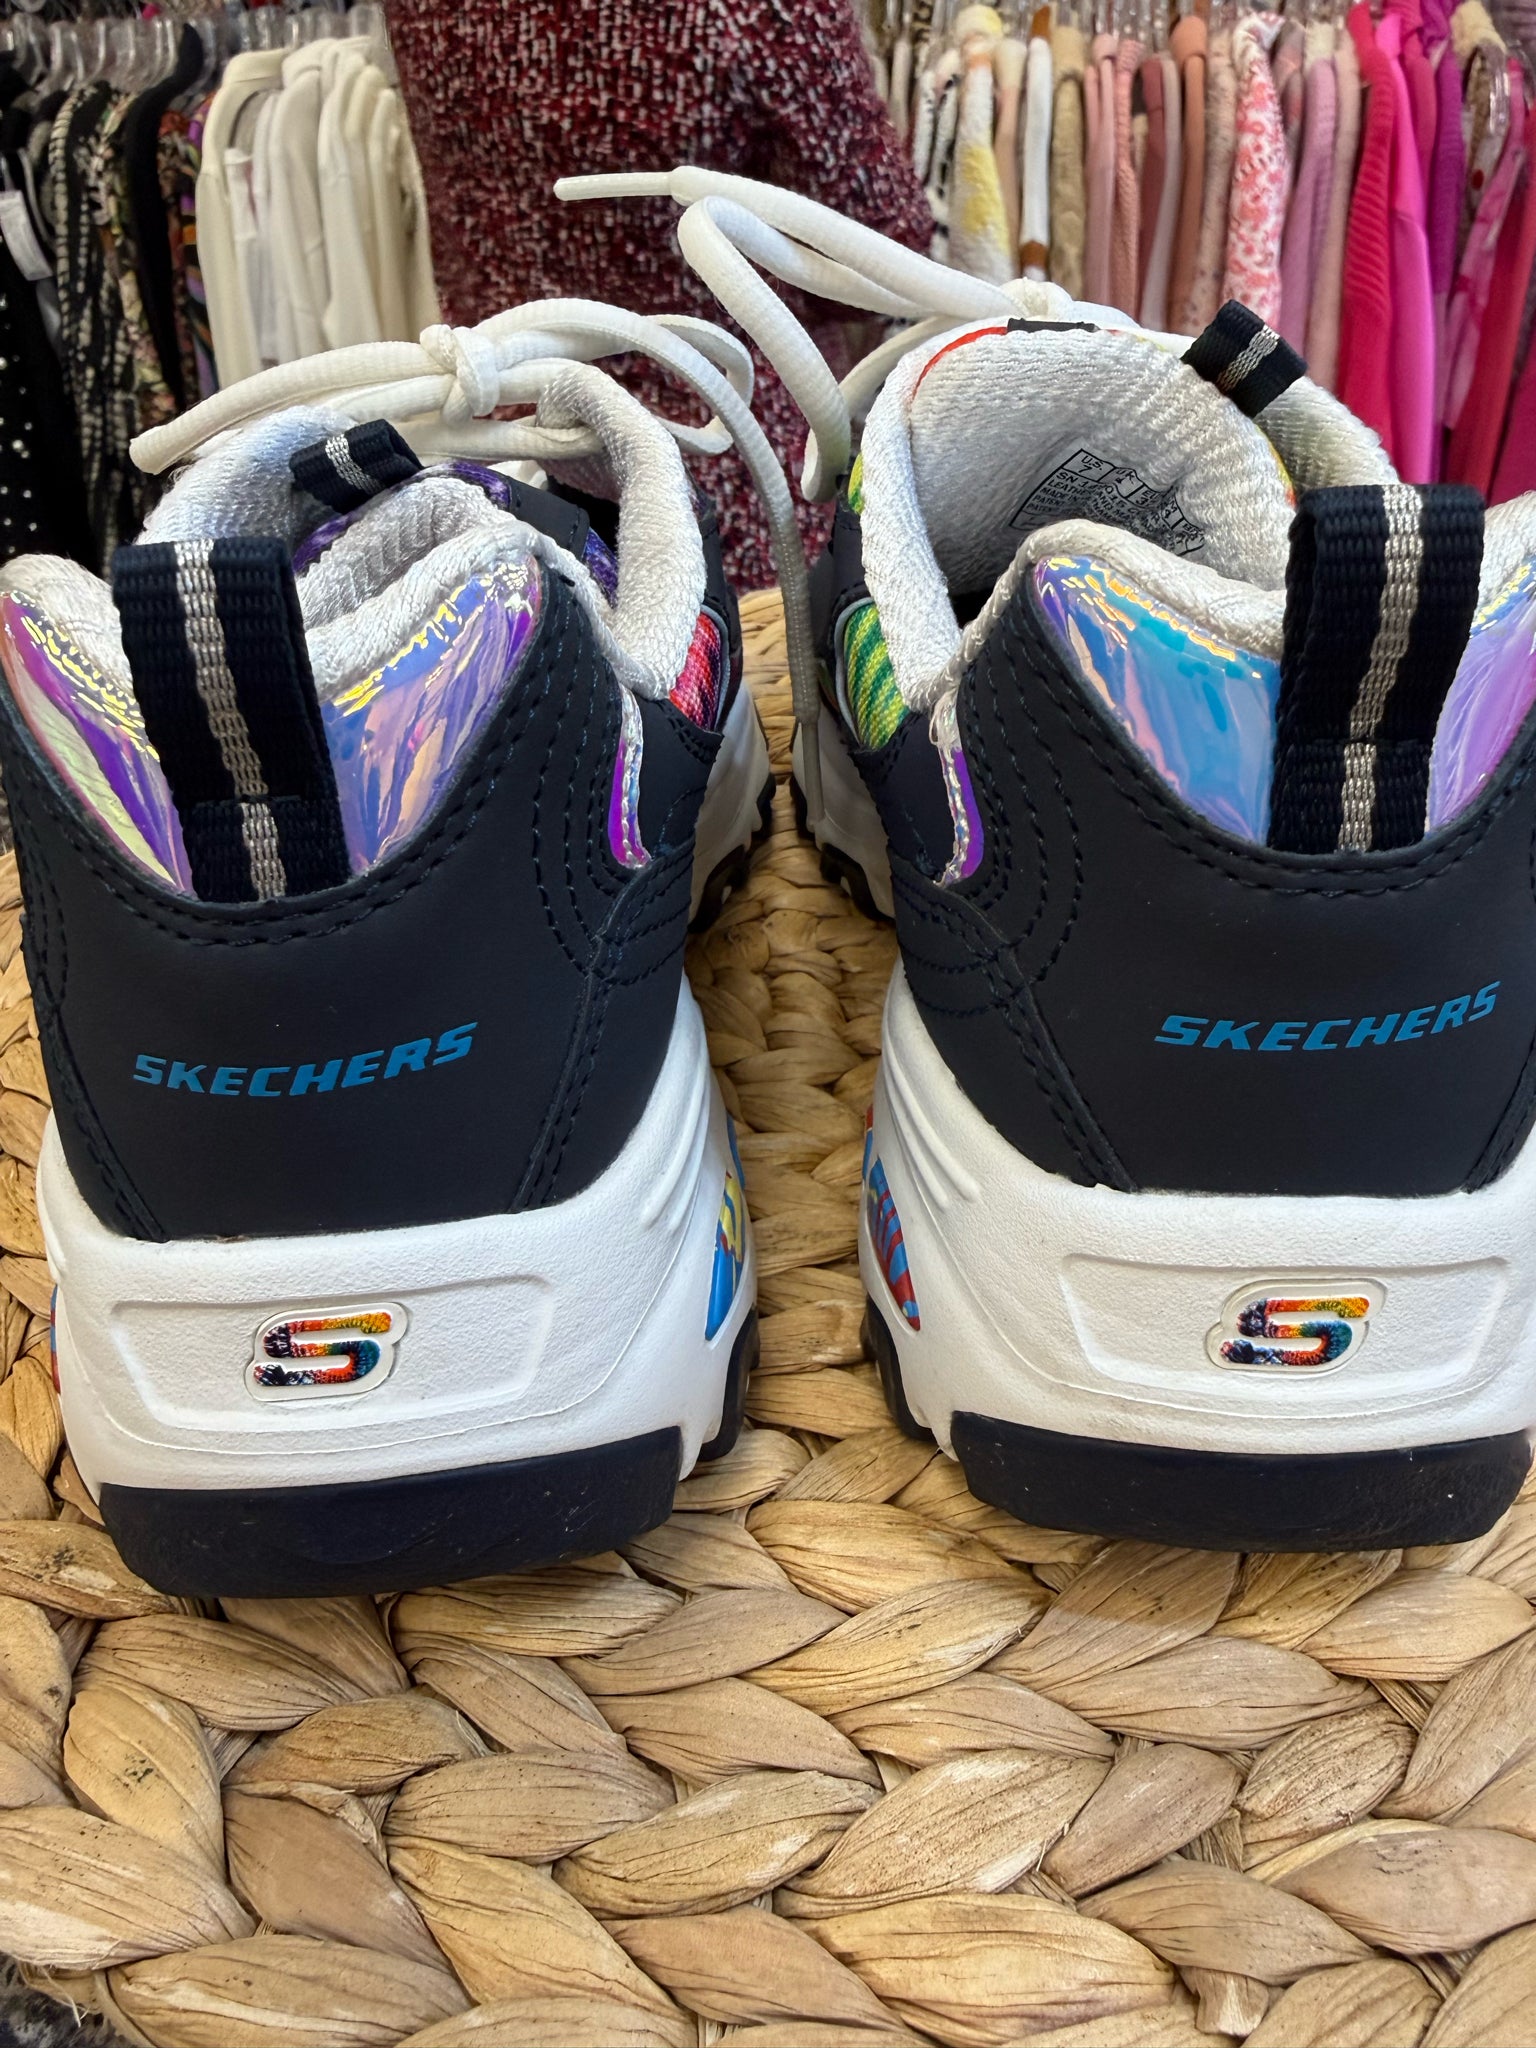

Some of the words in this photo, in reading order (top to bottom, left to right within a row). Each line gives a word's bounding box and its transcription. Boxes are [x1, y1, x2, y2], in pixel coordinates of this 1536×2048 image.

[1078, 464, 1093, 474] 7
[1081, 455, 1104, 471] U.S.
[1056, 471, 1079, 484] SN
[1040, 487, 1067, 499] MADE
[1154, 981, 1500, 1051] SKECHERS
[133, 1022, 478, 1097] SKECHERS
